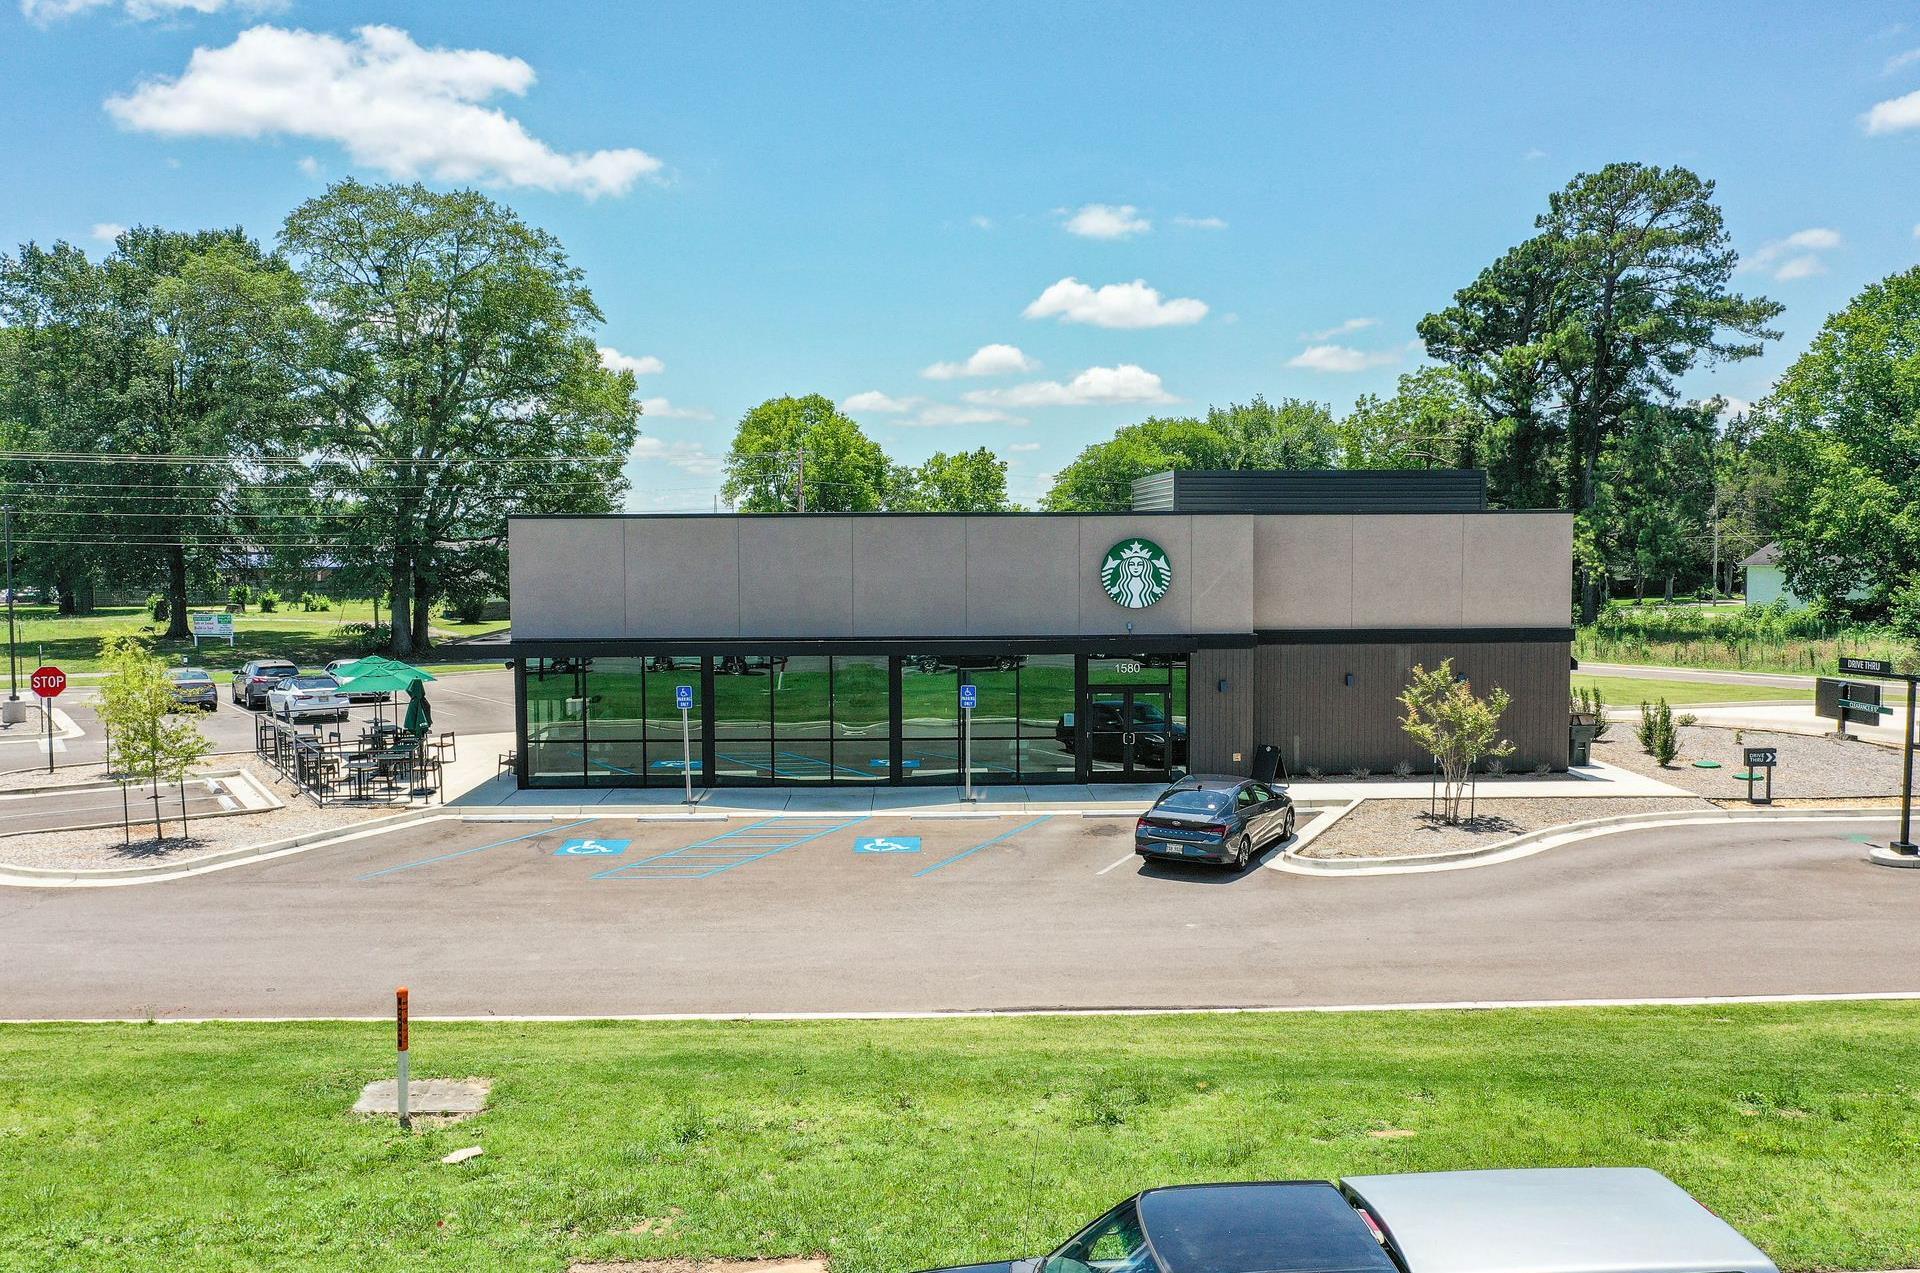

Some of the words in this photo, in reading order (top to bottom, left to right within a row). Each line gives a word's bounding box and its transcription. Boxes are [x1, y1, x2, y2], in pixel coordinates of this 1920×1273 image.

[1114, 663, 1140, 673] 1580
[1847, 659, 1864, 669] DRIVE
[1865, 661, 1881, 670] THRU
[33, 675, 64, 688] STOP
